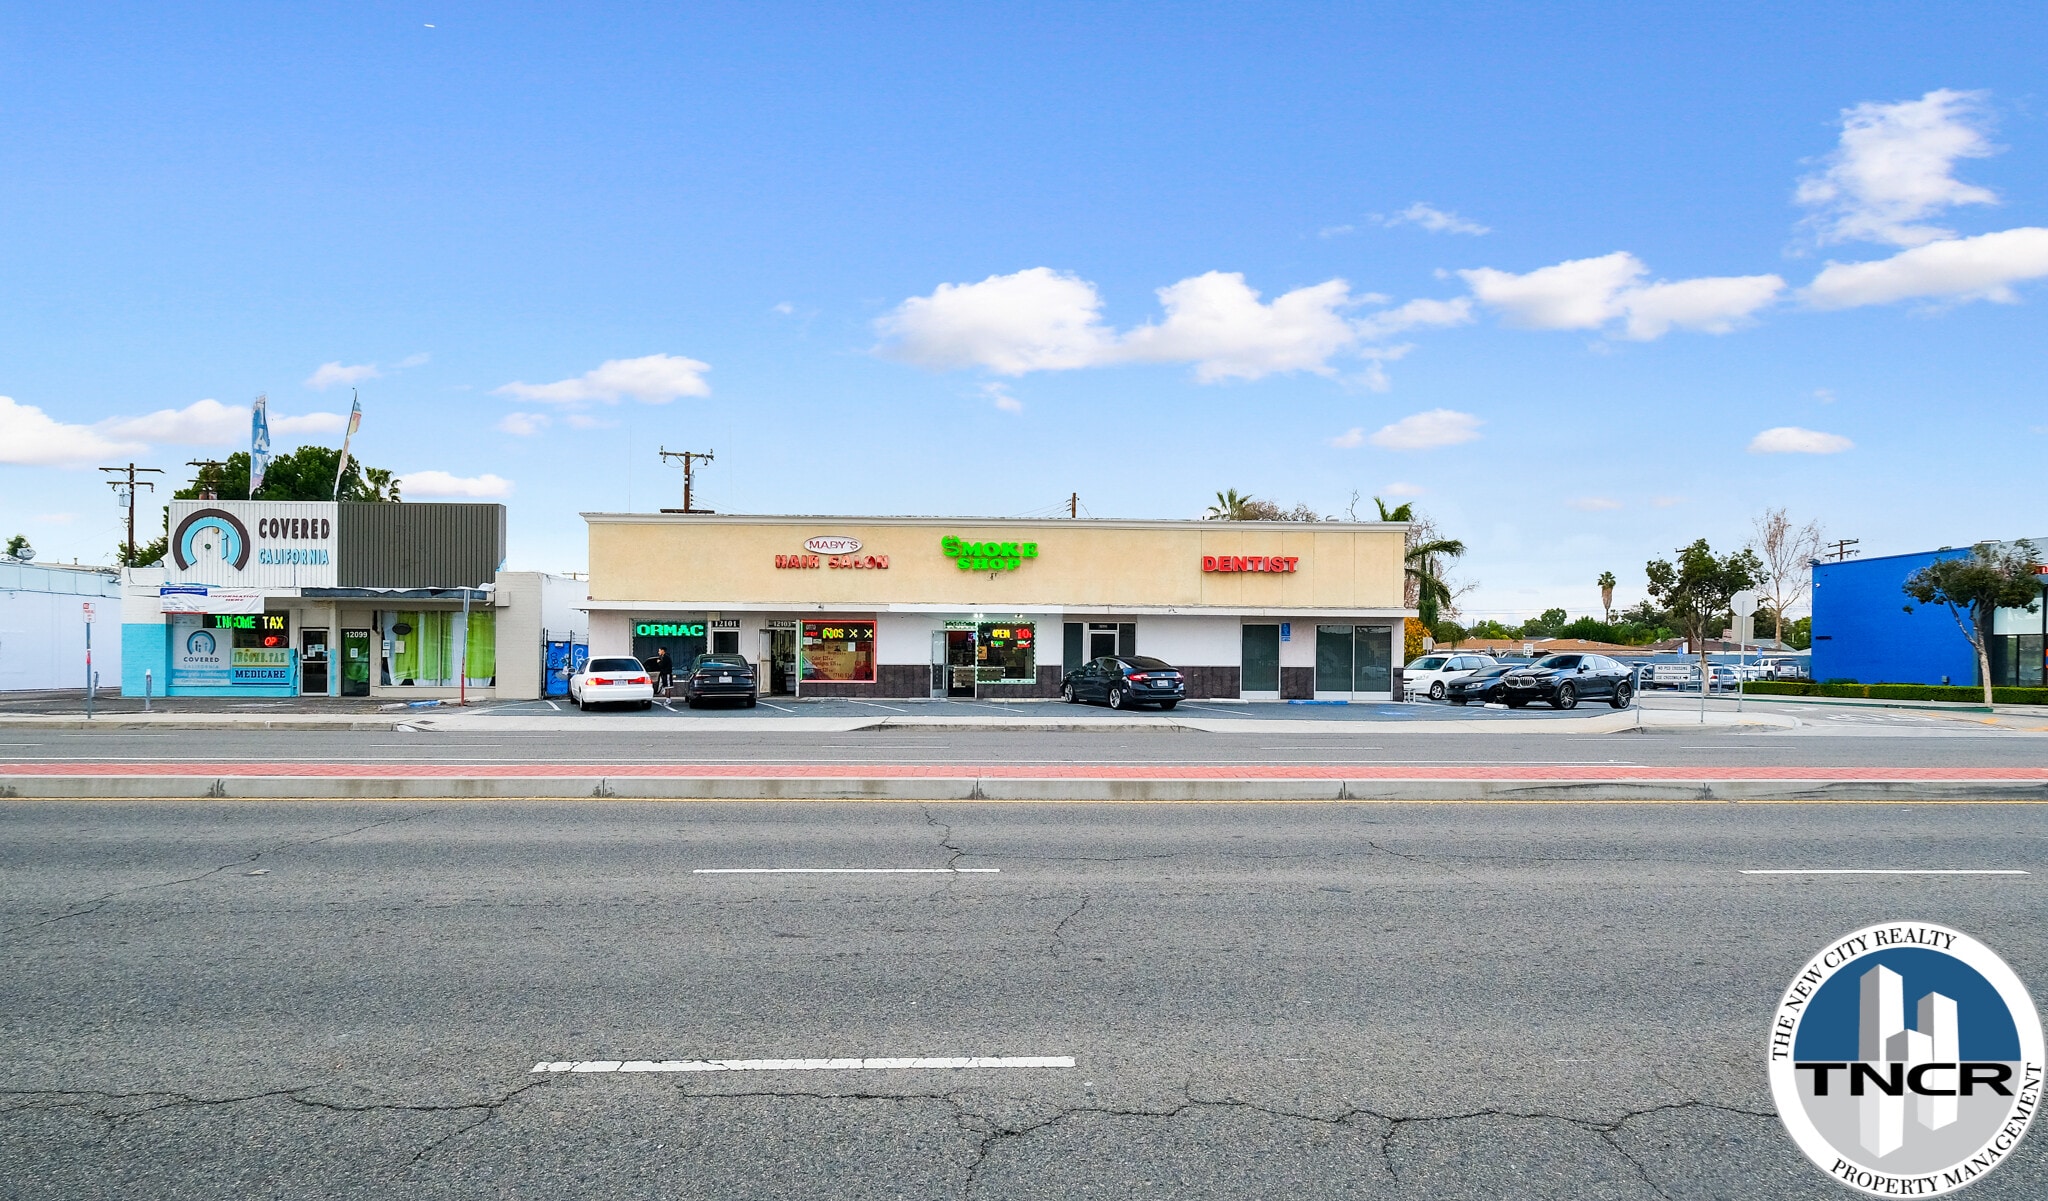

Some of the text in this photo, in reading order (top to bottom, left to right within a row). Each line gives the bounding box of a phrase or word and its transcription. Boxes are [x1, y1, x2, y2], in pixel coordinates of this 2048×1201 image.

[259, 518, 330, 539] COVERED
[809, 540, 859, 551] MABY'S
[941, 535, 1039, 557] SMOKE
[259, 548, 329, 565] CALIFORNIA
[775, 555, 889, 569] HAIR SALON
[957, 557, 1021, 571] SHOP
[1203, 556, 1299, 572] DENTIST
[262, 616, 284, 629] TAX
[714, 620, 737, 628] 12101
[636, 624, 704, 636] ORMAC
[235, 670, 286, 679] MEDICARE
